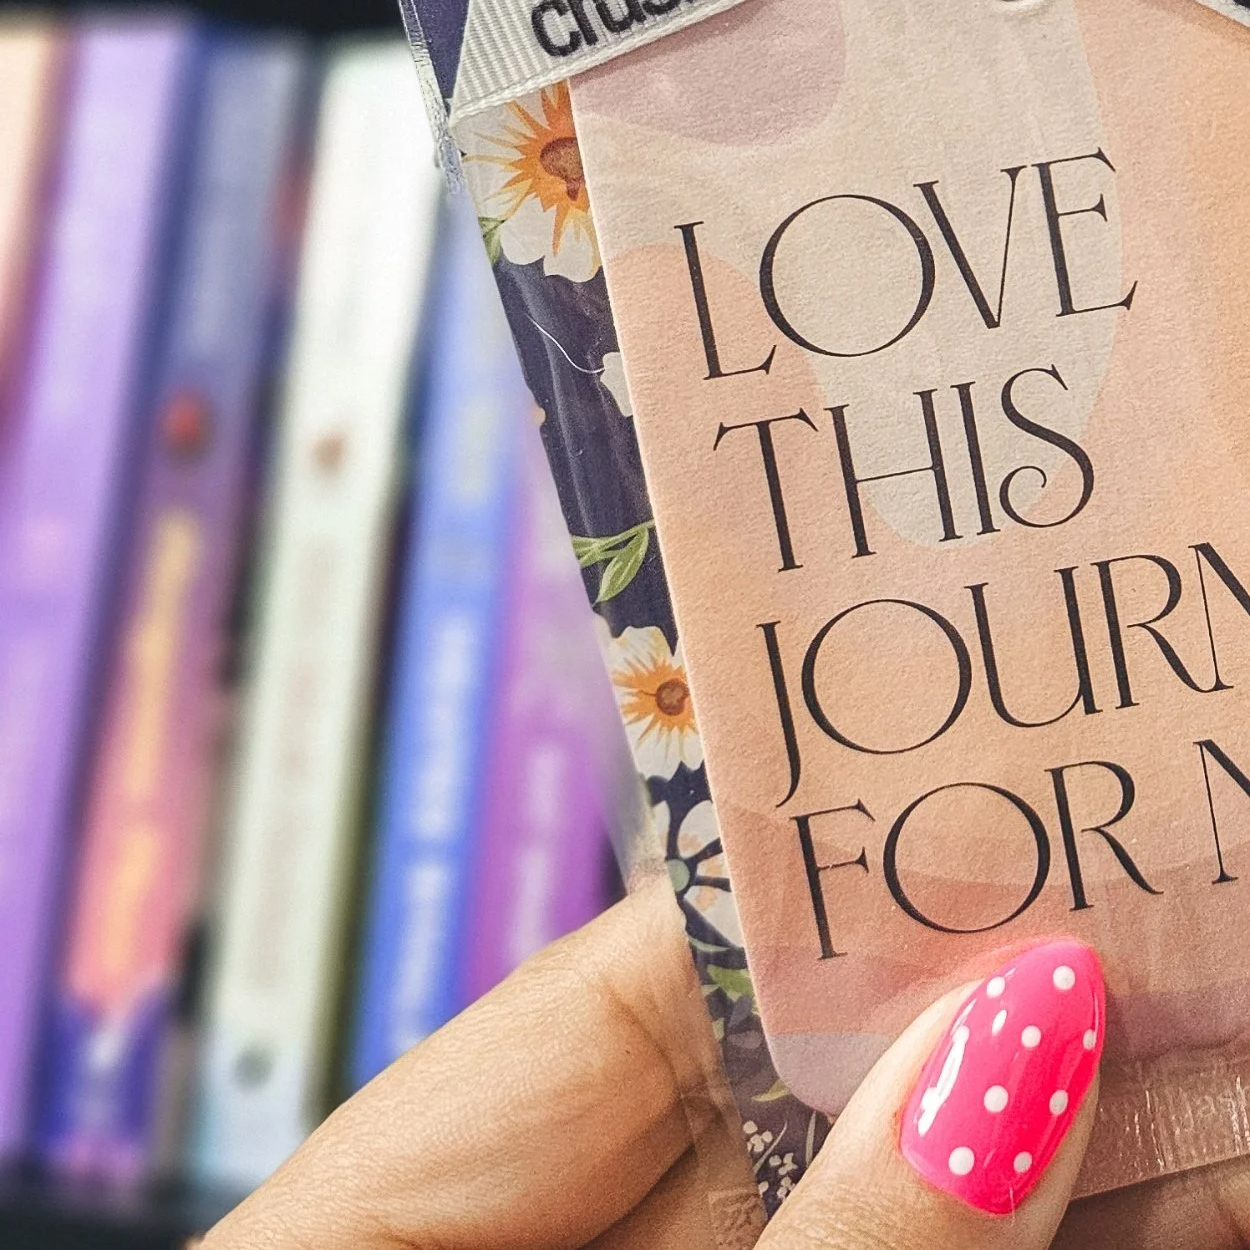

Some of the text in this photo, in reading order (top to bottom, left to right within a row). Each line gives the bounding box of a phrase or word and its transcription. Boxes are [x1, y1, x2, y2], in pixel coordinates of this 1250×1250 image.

[674, 146, 1139, 381] LOVE
[713, 364, 1095, 573] THIS
[791, 760, 1164, 961] FOR
